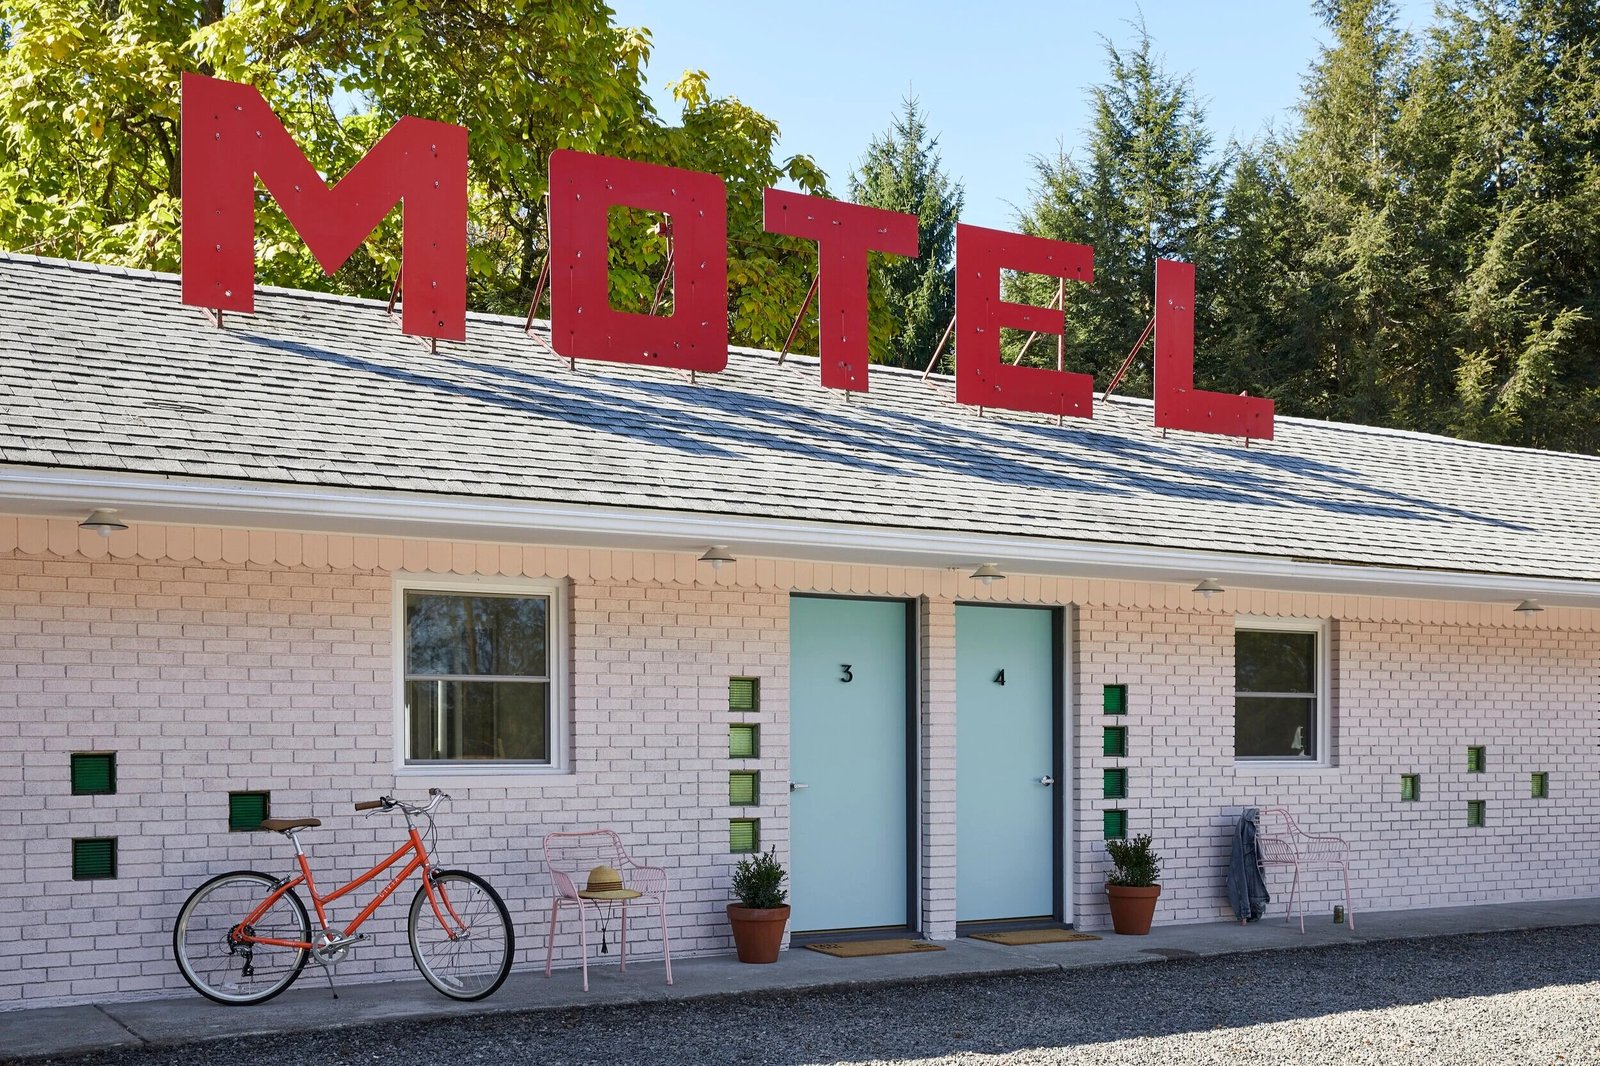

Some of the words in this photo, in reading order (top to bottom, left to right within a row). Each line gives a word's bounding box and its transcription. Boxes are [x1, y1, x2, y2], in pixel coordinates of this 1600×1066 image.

[182, 72, 1275, 440] MOTEL
[840, 664, 853, 682] 3
[993, 668, 1006, 686] 4
